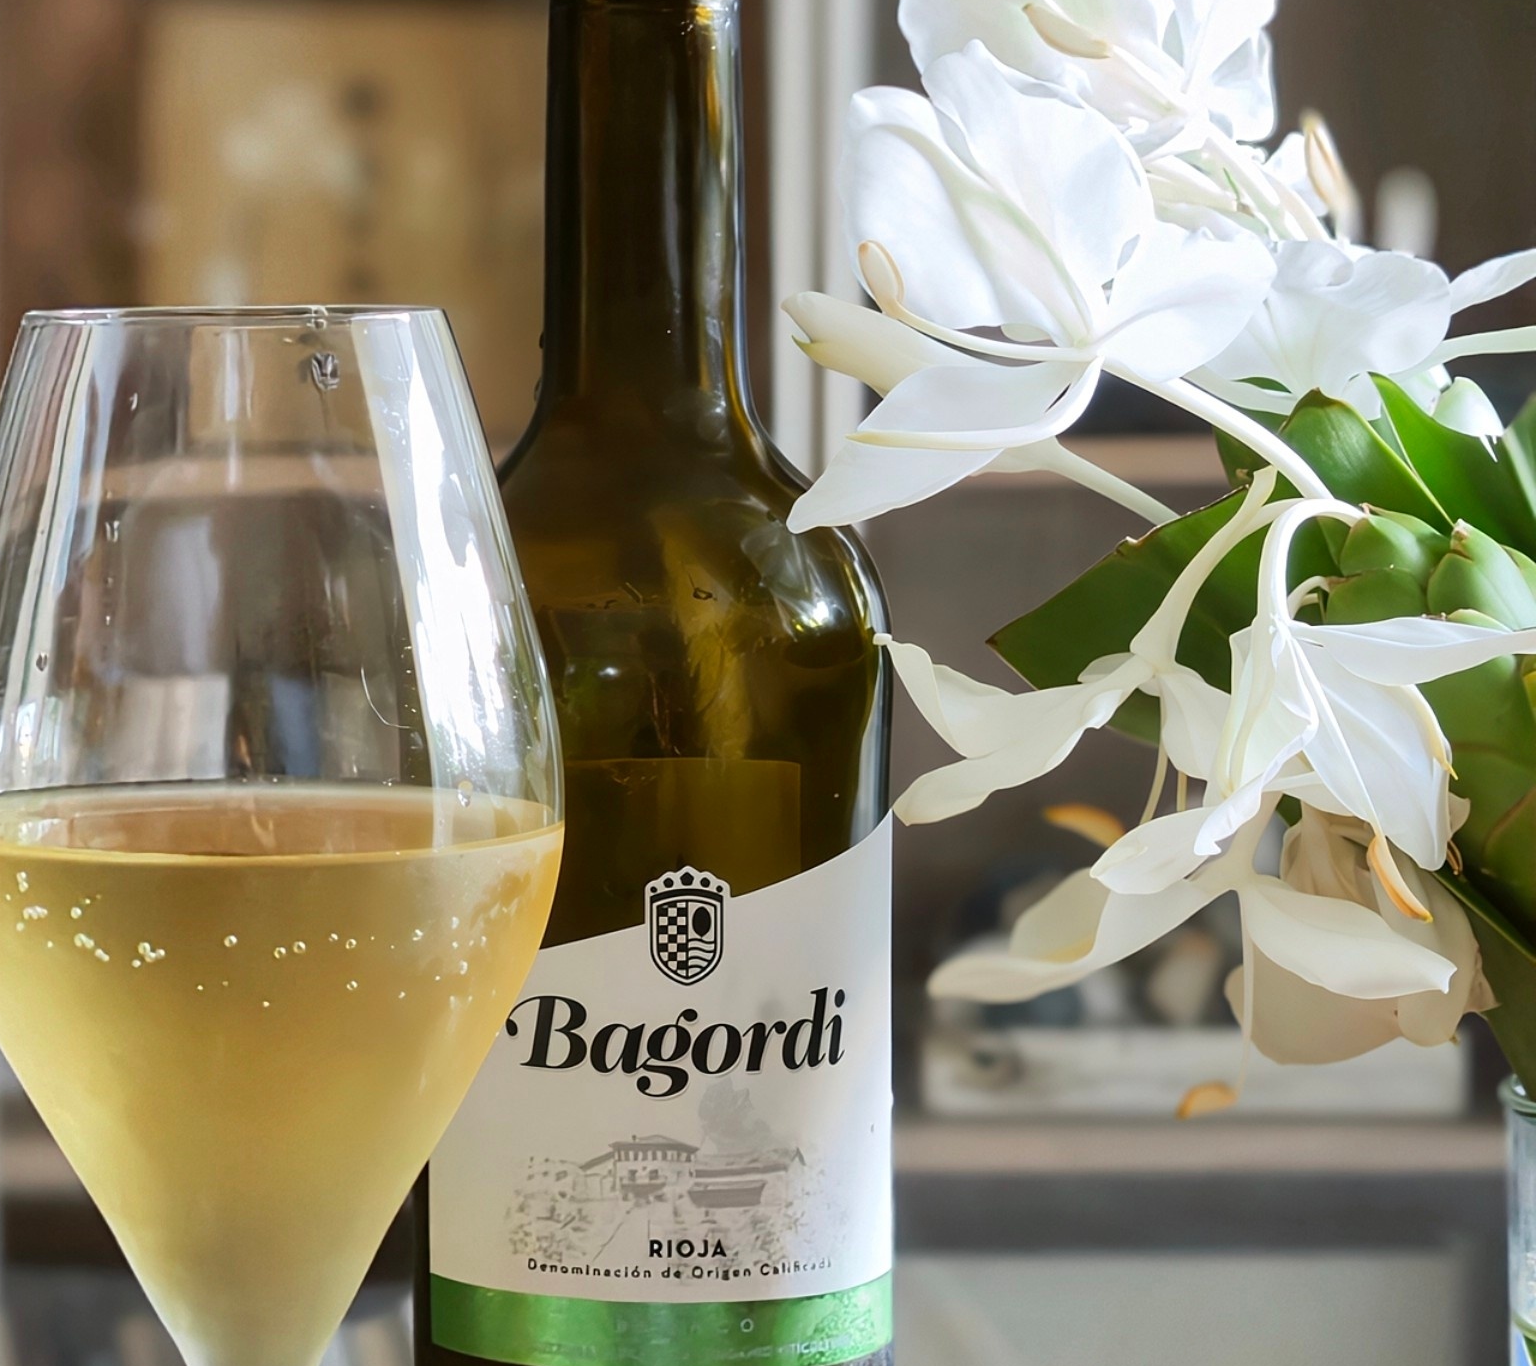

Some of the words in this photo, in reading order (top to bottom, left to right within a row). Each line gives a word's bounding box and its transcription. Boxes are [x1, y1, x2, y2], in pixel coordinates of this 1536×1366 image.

[505, 986, 846, 1098] Bagordi
[648, 1238, 727, 1259] RIOJA
[527, 1257, 653, 1279] Denominación
[660, 1266, 682, 1279] de
[691, 1265, 752, 1281] Origen
